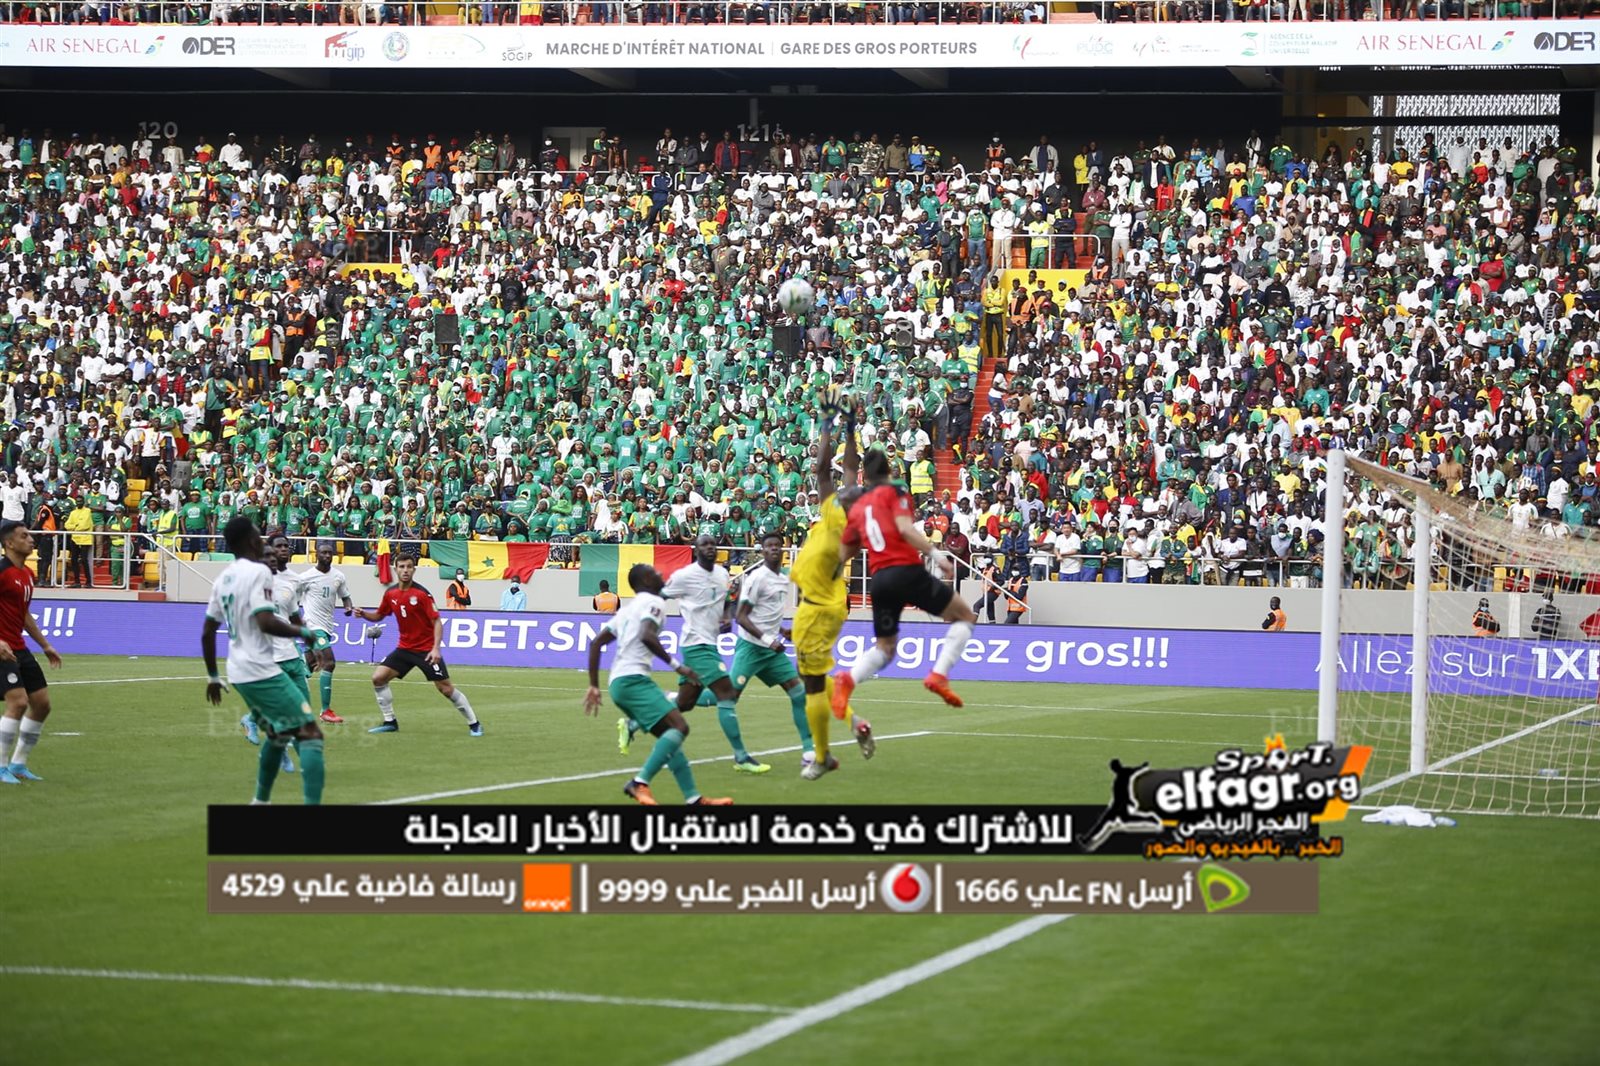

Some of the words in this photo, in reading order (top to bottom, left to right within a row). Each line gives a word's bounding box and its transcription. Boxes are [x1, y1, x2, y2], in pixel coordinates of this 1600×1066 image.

[26, 38, 57, 54] AIR
[62, 37, 142, 54] SENEGAL
[546, 43, 610, 55] MARCHE
[613, 39, 685, 55] D'INTÉRÊT
[689, 42, 765, 55] NATIONAL
[780, 42, 820, 55] GARE
[823, 42, 851, 55] DES
[854, 42, 896, 55] GROS
[899, 42, 978, 55] PORTEURS
[1356, 35, 1391, 50] AIR
[1396, 34, 1487, 50] SENEGAL
[502, 52, 533, 62] SOGIP
[138, 121, 178, 139] 120
[737, 124, 769, 141] 121
[865, 505, 886, 552] 6
[322, 586, 330, 598] 21
[400, 605, 407, 618] 5
[1024, 635, 1170, 673] gros!!!
[1442, 651, 1516, 678] sur
